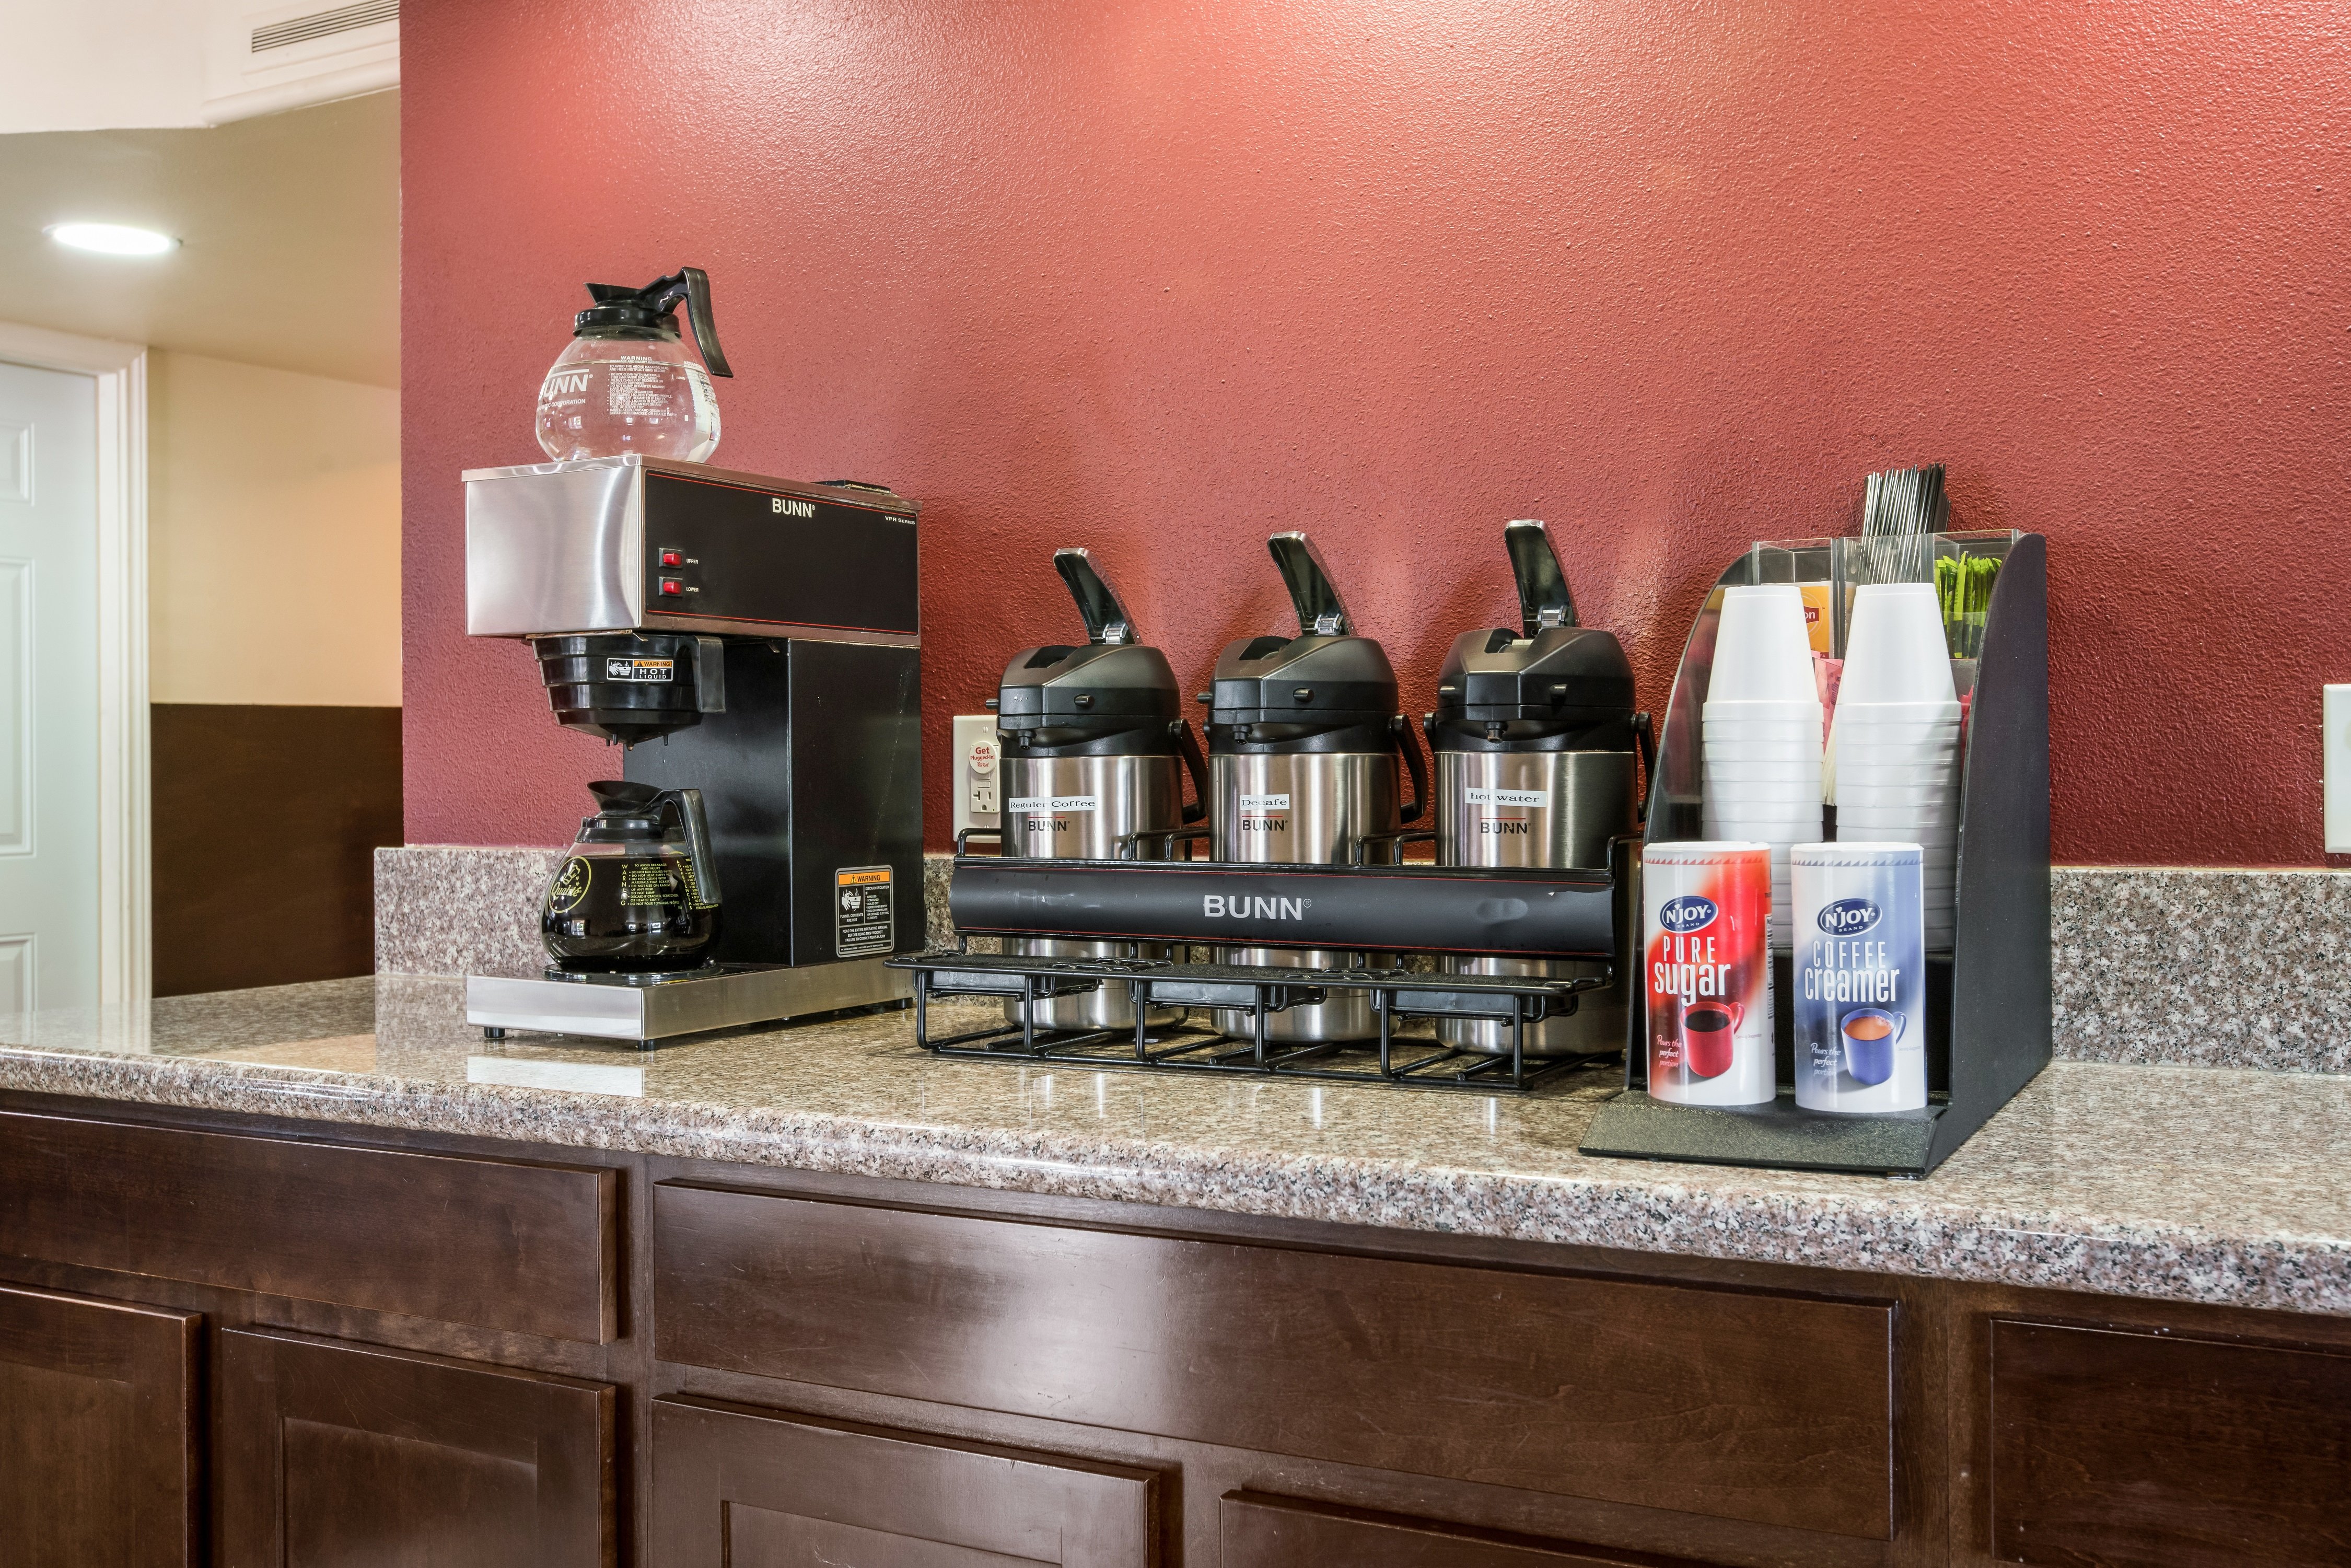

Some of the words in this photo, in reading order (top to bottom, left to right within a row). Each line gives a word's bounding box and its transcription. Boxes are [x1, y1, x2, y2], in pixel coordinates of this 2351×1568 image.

[551, 399, 586, 407] CORPORATION
[772, 497, 812, 518] BUNN
[1029, 821, 1067, 831] BUNN
[1242, 820, 1284, 831] BUNN
[1481, 822, 1527, 834] BUNN
[1203, 895, 1302, 920] BUNN
[1663, 936, 1715, 963] PURE
[1813, 940, 1886, 968] COFFEE
[1654, 962, 1731, 1007] sugar
[1805, 967, 1900, 1003] creamer
[1657, 1035, 1671, 1046] Pours
[1672, 1039, 1682, 1048] the
[1659, 1048, 1679, 1059] perfect
[1810, 1042, 1828, 1055] Pours
[1829, 1047, 1841, 1056] the
[1659, 1060, 1679, 1068] portion
[1813, 1056, 1837, 1067] perfect
[1813, 1068, 1837, 1077] portion
